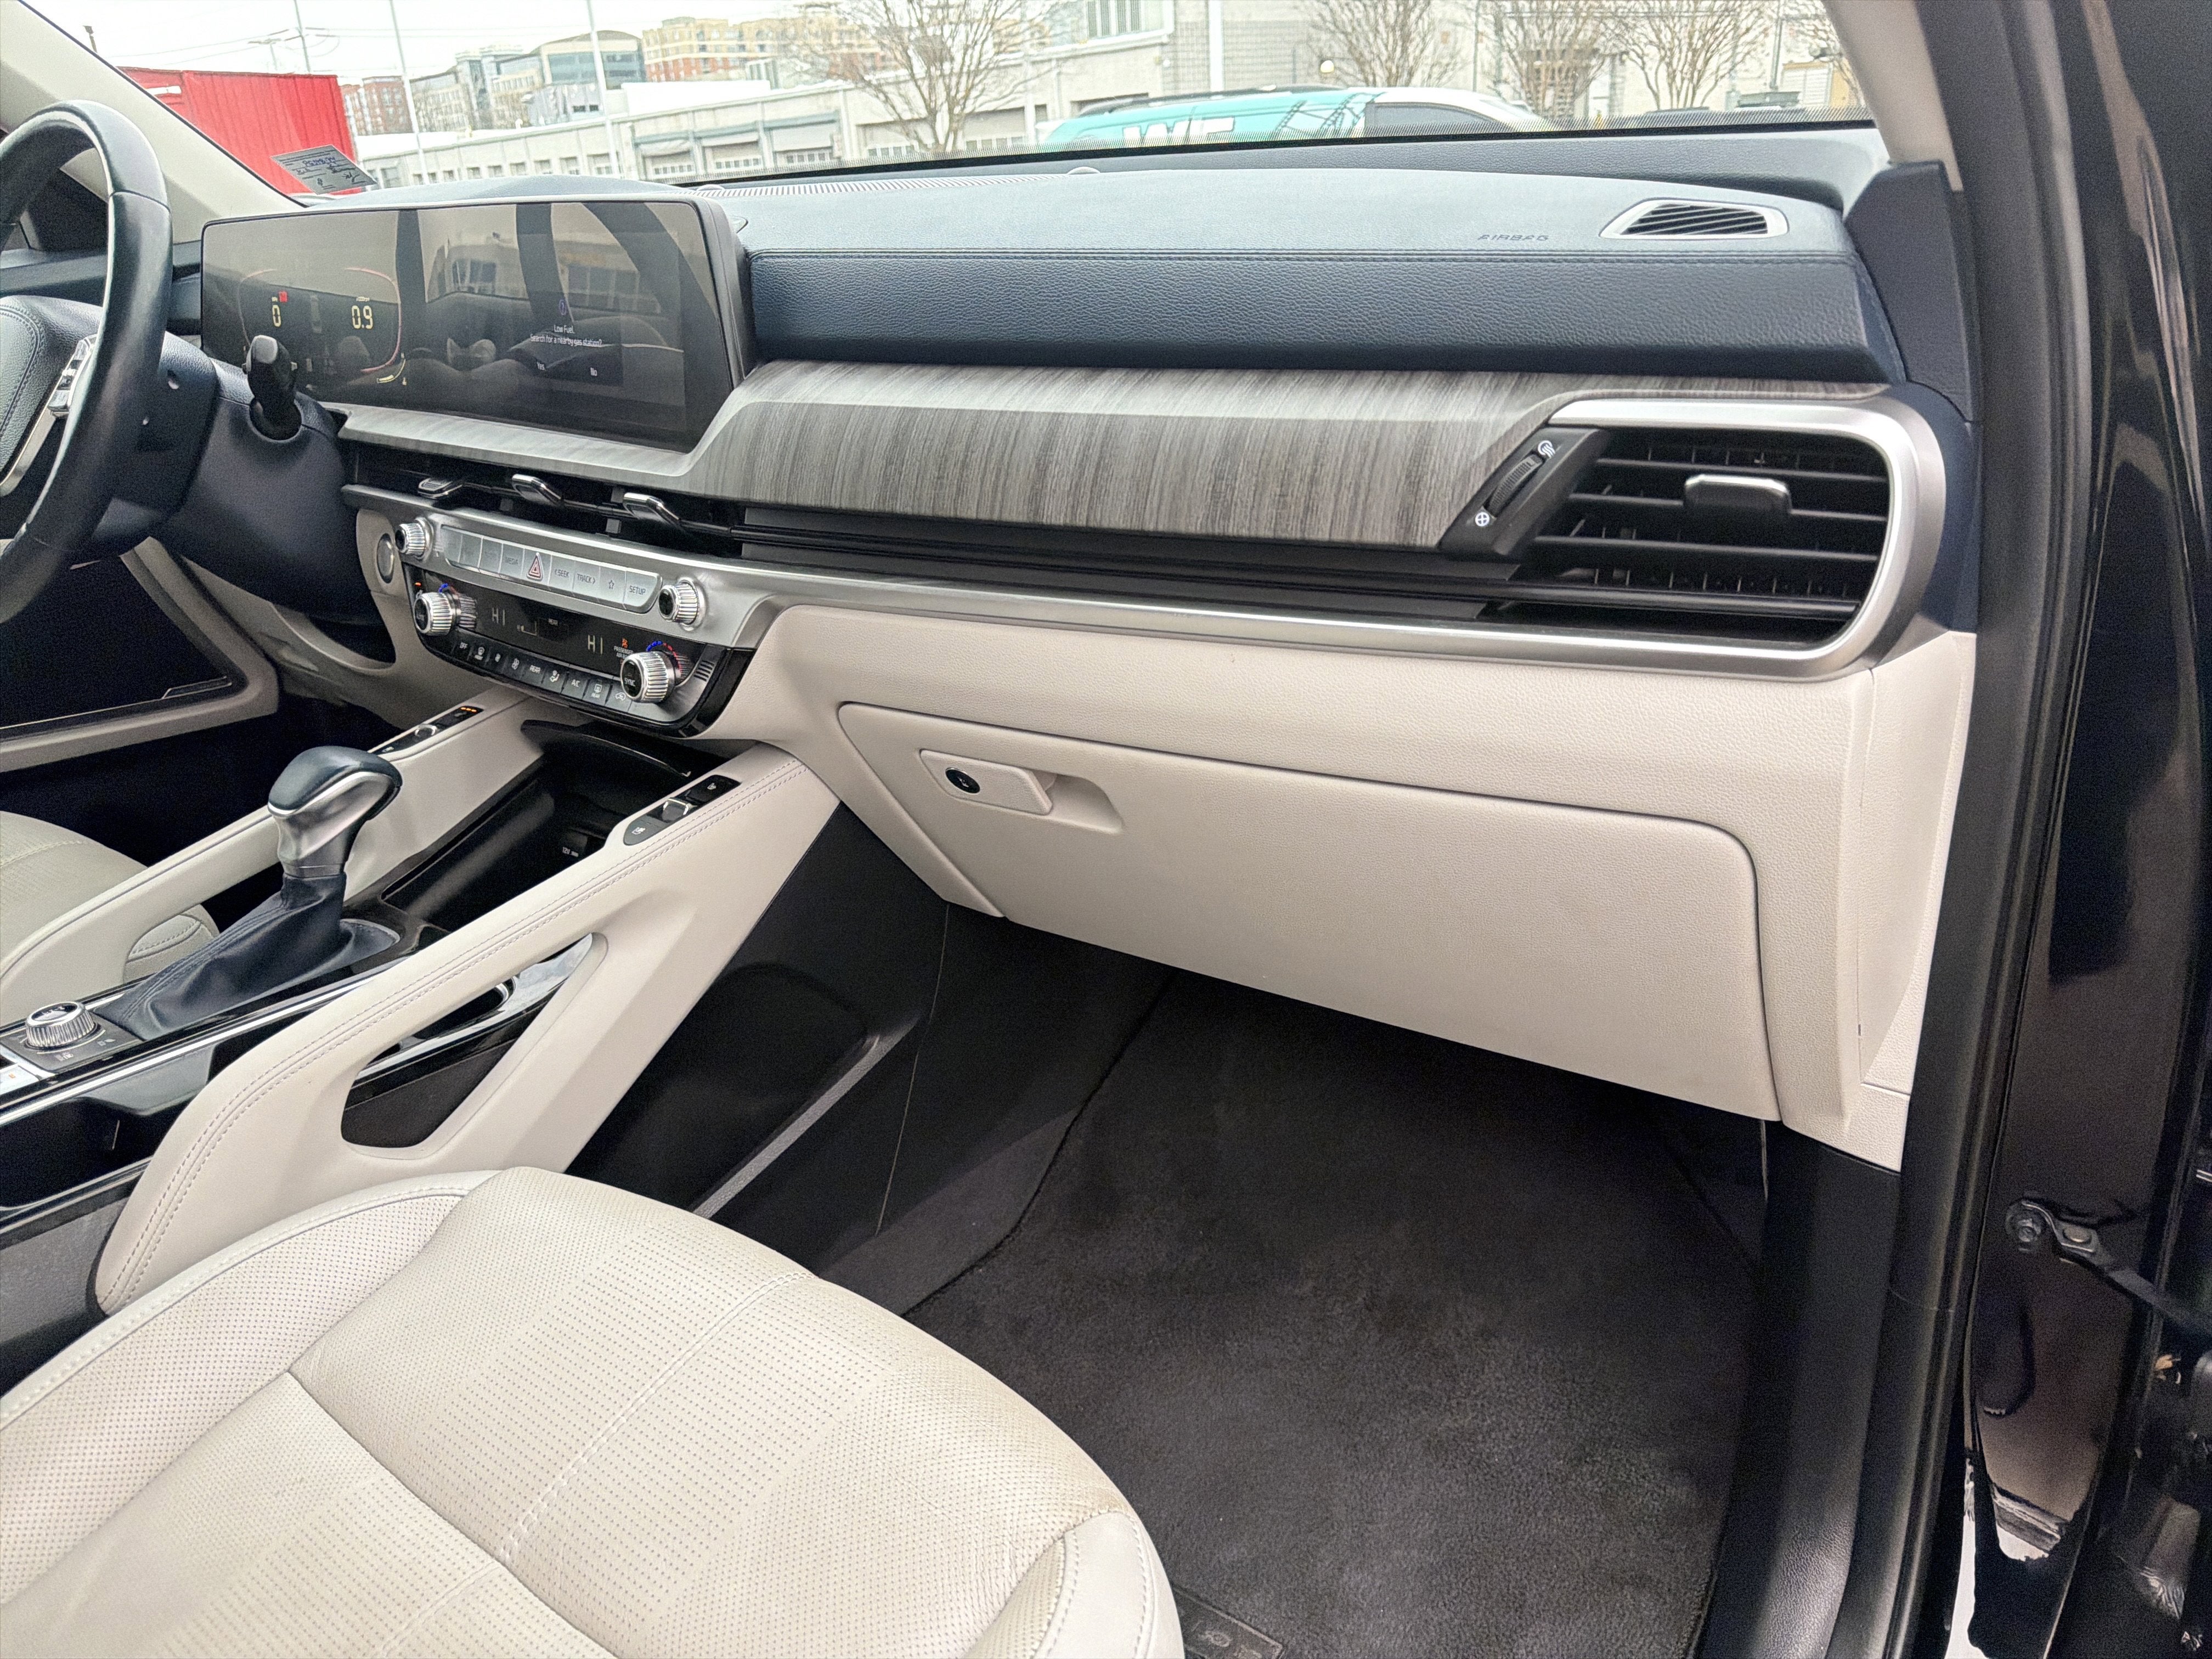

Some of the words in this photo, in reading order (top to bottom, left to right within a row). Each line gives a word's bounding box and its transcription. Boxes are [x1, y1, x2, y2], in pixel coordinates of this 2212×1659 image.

[272, 304, 281, 328] 0
[351, 305, 374, 329] 0.9
[554, 324, 563, 333] Low
[531, 334, 545, 342] Search
[557, 337, 573, 346] nearby
[583, 338, 602, 348] station?
[590, 367, 597, 376] No
[629, 585, 646, 595] SETUP
[588, 634, 603, 655] HI
[614, 645, 634, 655] PASSENGER
[529, 664, 541, 674] REAR
[571, 679, 580, 687] A/C
[624, 677, 635, 687] SYNC
